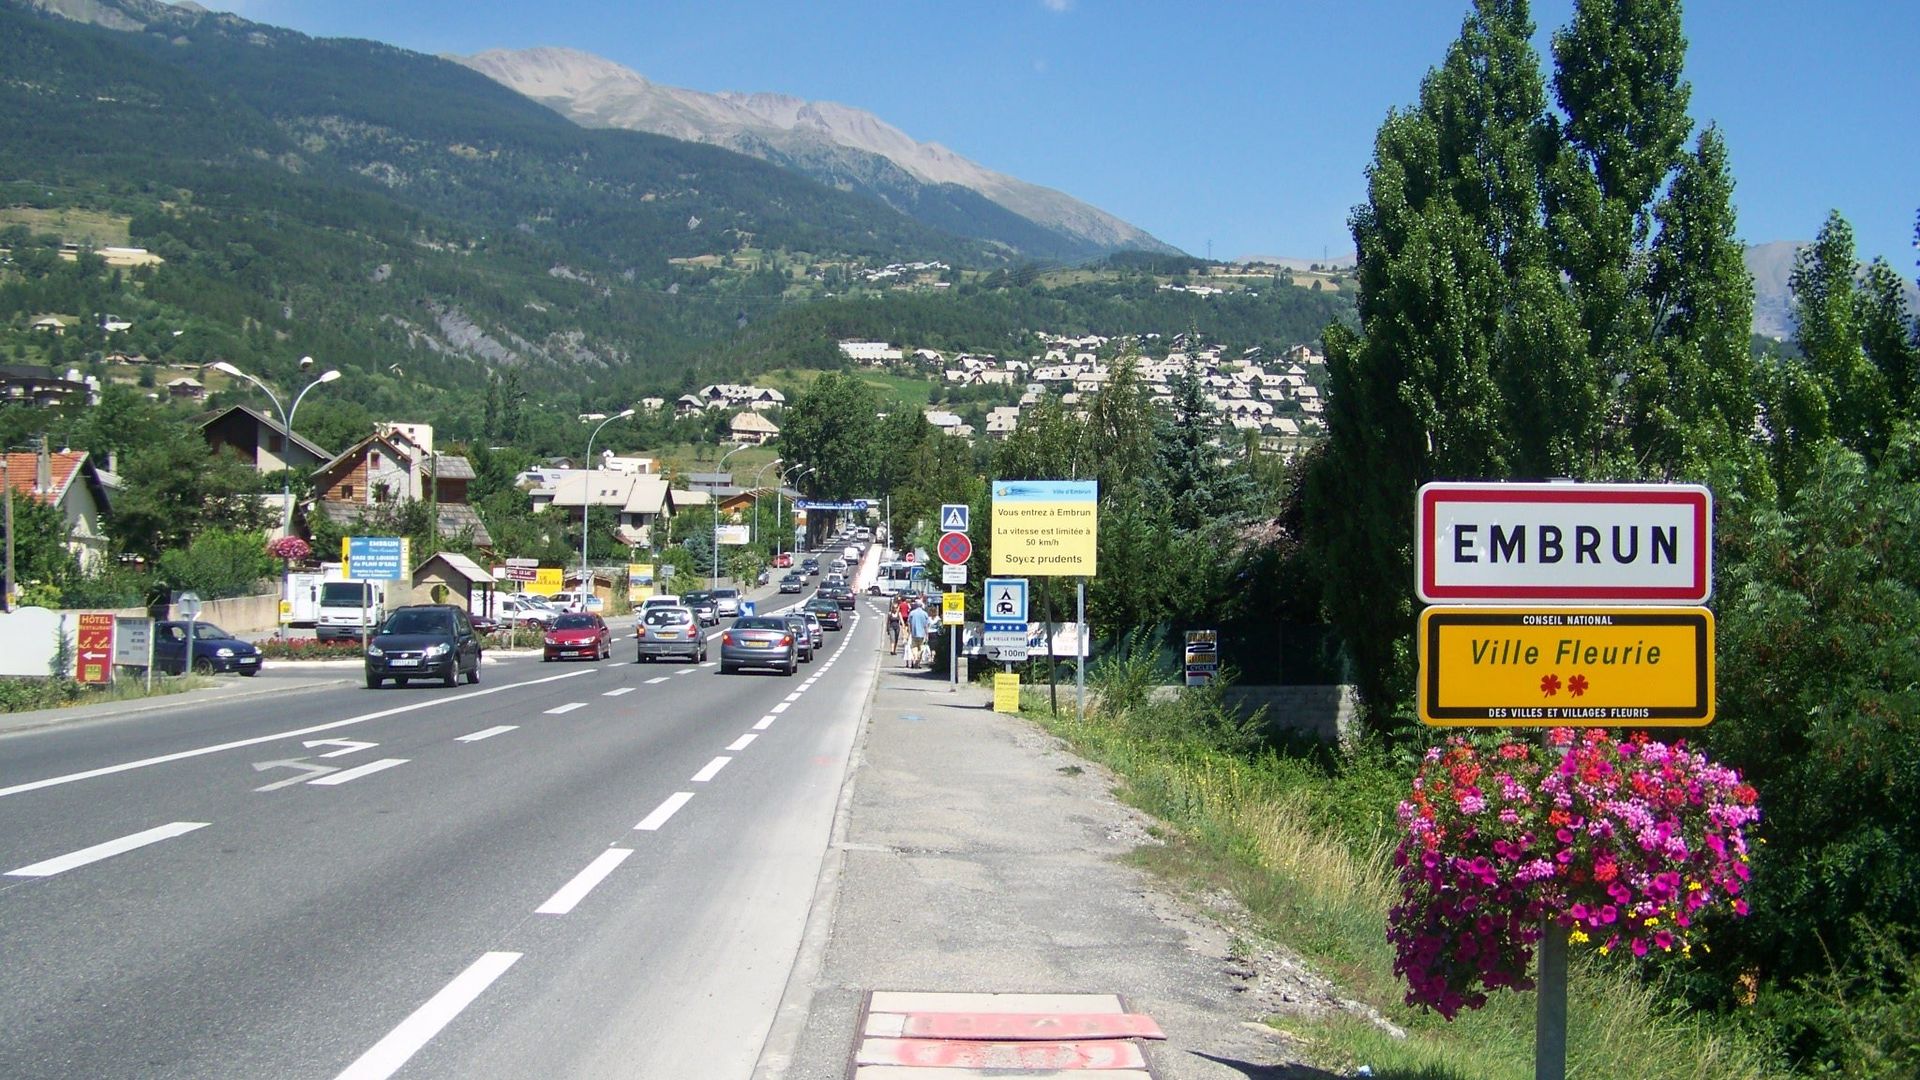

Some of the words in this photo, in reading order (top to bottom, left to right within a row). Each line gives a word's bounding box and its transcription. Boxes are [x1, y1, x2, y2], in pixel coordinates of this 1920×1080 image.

[997, 508, 1019, 517] Vous
[1020, 509, 1048, 517] entrez
[1049, 508, 1055, 517] à
[1057, 508, 1091, 517] Embrun
[997, 527, 1008, 535] La
[1009, 527, 1039, 535] vitesse
[1041, 527, 1054, 535] est
[1056, 527, 1084, 535] limitée
[1085, 527, 1091, 535] à
[1025, 538, 1036, 546] 50
[1038, 538, 1059, 546] km/h
[1454, 524, 1678, 565] EMBRUN
[1005, 554, 1035, 565] Soyez
[1037, 554, 1083, 565] prudents
[82, 614, 111, 624] HÔTEL
[1522, 615, 1563, 625] CONSEIL
[1566, 615, 1613, 625] NATIONAL
[1004, 649, 1026, 657] 100m
[1471, 639, 1539, 665] Ville
[1555, 639, 1661, 665] Fleurie
[1488, 708, 1507, 718] DES
[1511, 708, 1543, 718] VILLES
[1547, 708, 1558, 718] ET
[1562, 708, 1607, 718] VILLAGES
[1611, 708, 1650, 718] FLEURIS
